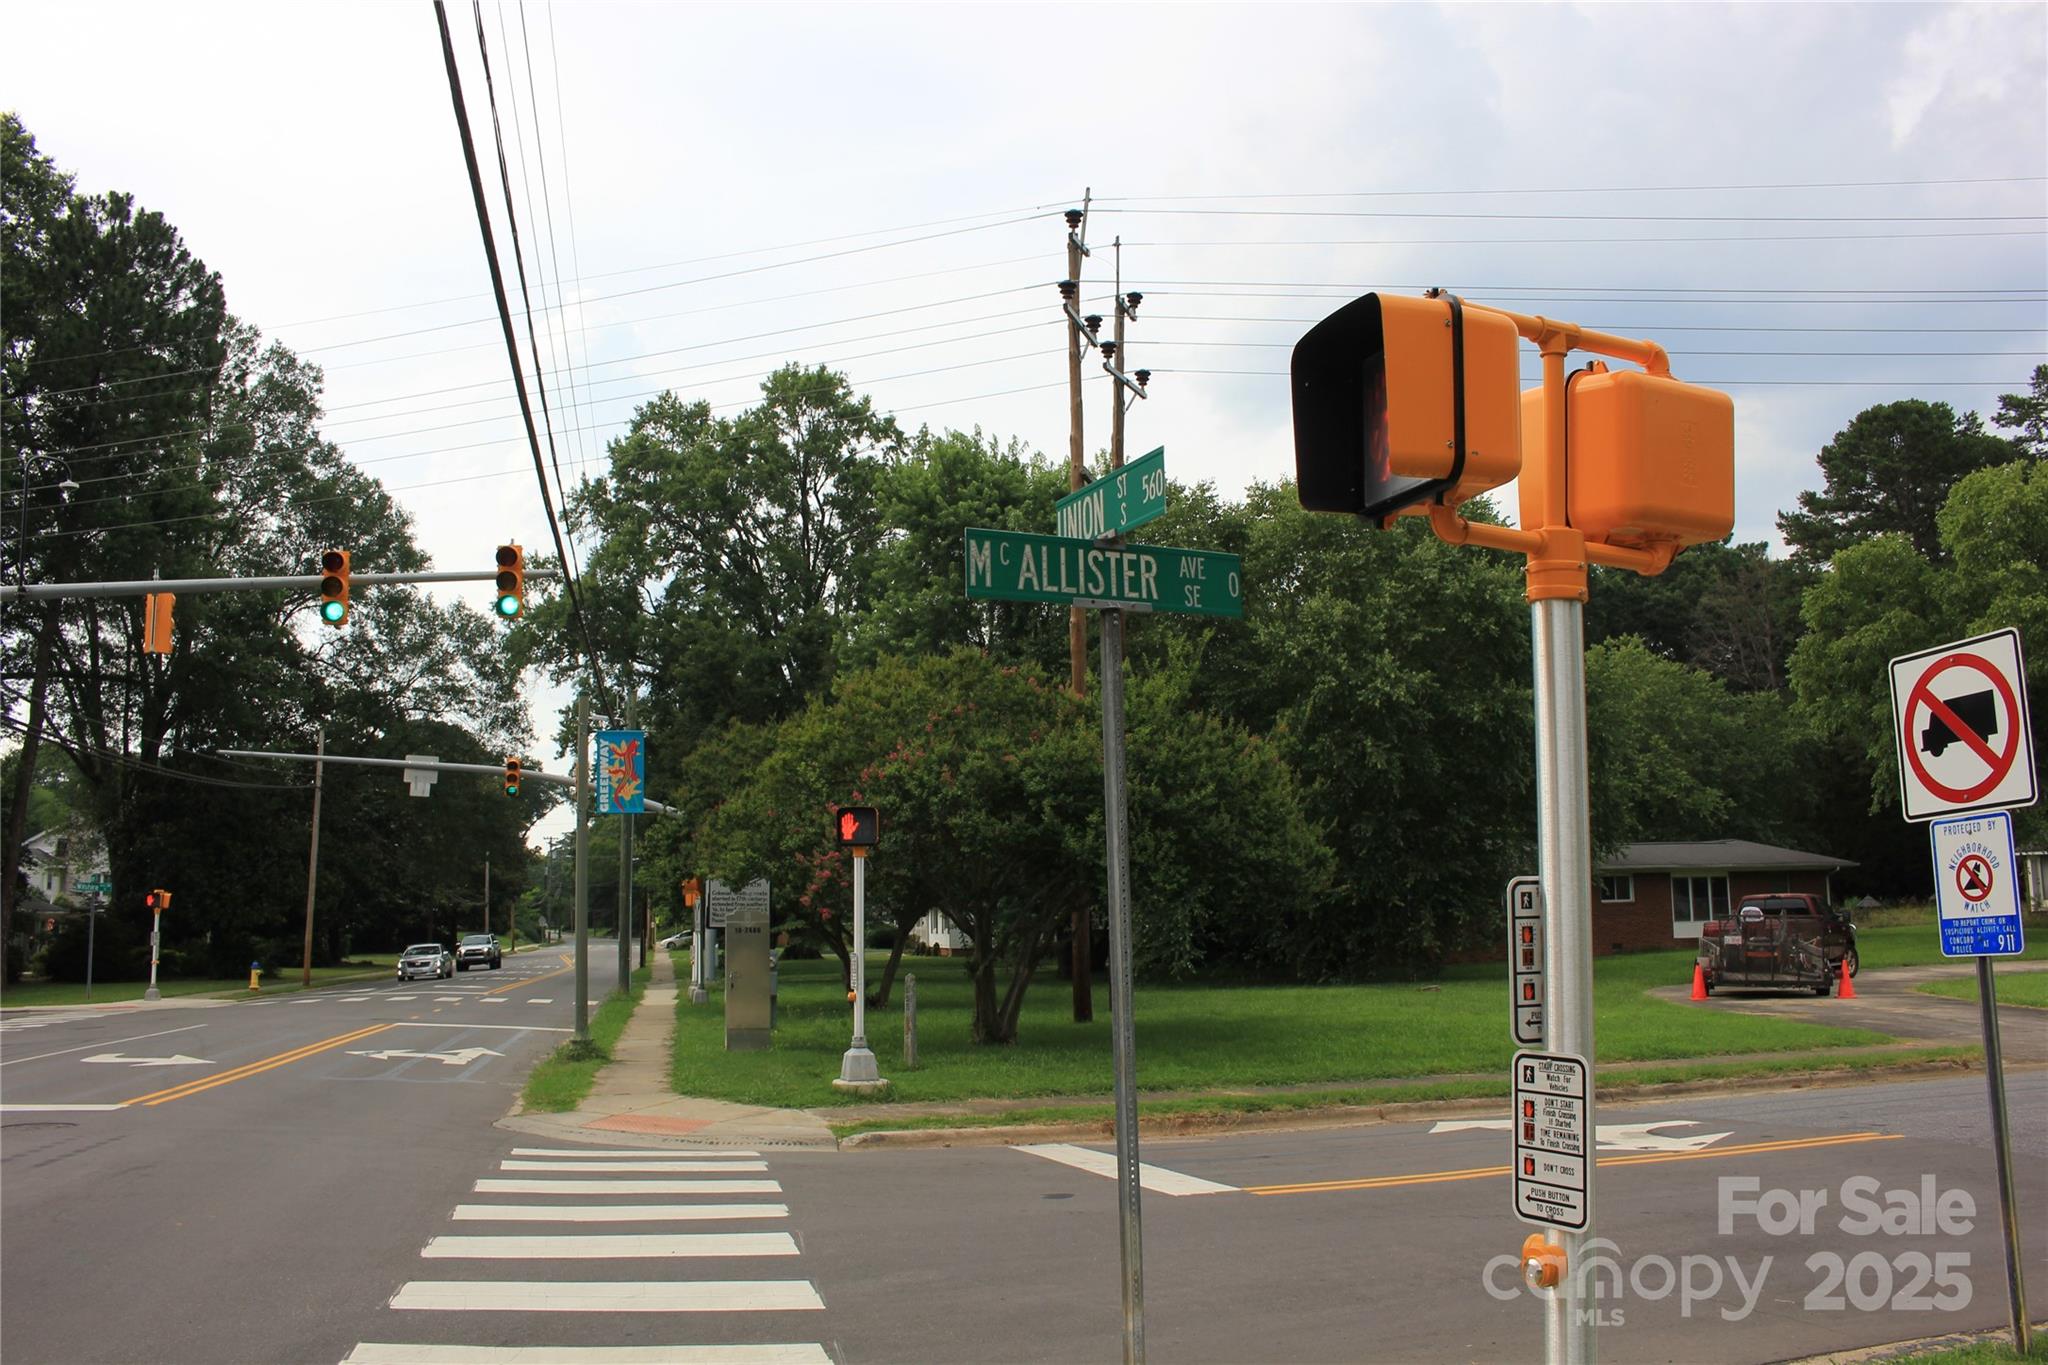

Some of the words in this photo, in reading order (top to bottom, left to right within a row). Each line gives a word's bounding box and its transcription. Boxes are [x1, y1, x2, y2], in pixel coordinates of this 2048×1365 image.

[1057, 489, 1105, 540] UNION
[1116, 472, 1128, 499] ST
[1142, 468, 1164, 505] 560
[1120, 503, 1128, 527] S
[1179, 555, 1207, 581] AVE
[1184, 585, 1202, 608] SE
[1943, 822, 1981, 836] PROTECTED
[1988, 820, 1996, 831] BY
[1948, 842, 2000, 871] NEIGHBORHOOD
[1964, 900, 1991, 913] WATCH
[1960, 918, 1979, 926] REPORT
[1949, 935, 1974, 945] CONCORD
[1998, 934, 2015, 951] 911
[1952, 945, 1973, 953] POLICE
[1544, 1097, 1558, 1106] DON'T
[1560, 1100, 1574, 1110] START
[1555, 1118, 1571, 1129] Started
[1540, 1128, 1551, 1138] TIME
[1553, 1130, 1580, 1142] REMAINING
[1543, 1163, 1558, 1173] DON'T
[1559, 1165, 1575, 1176] CROSS
[1531, 1187, 1546, 1198] PUSH
[1548, 1189, 1570, 1202] BUTTON
[1536, 1203, 1545, 1213] TO
[1545, 1205, 1564, 1217] CROSS
